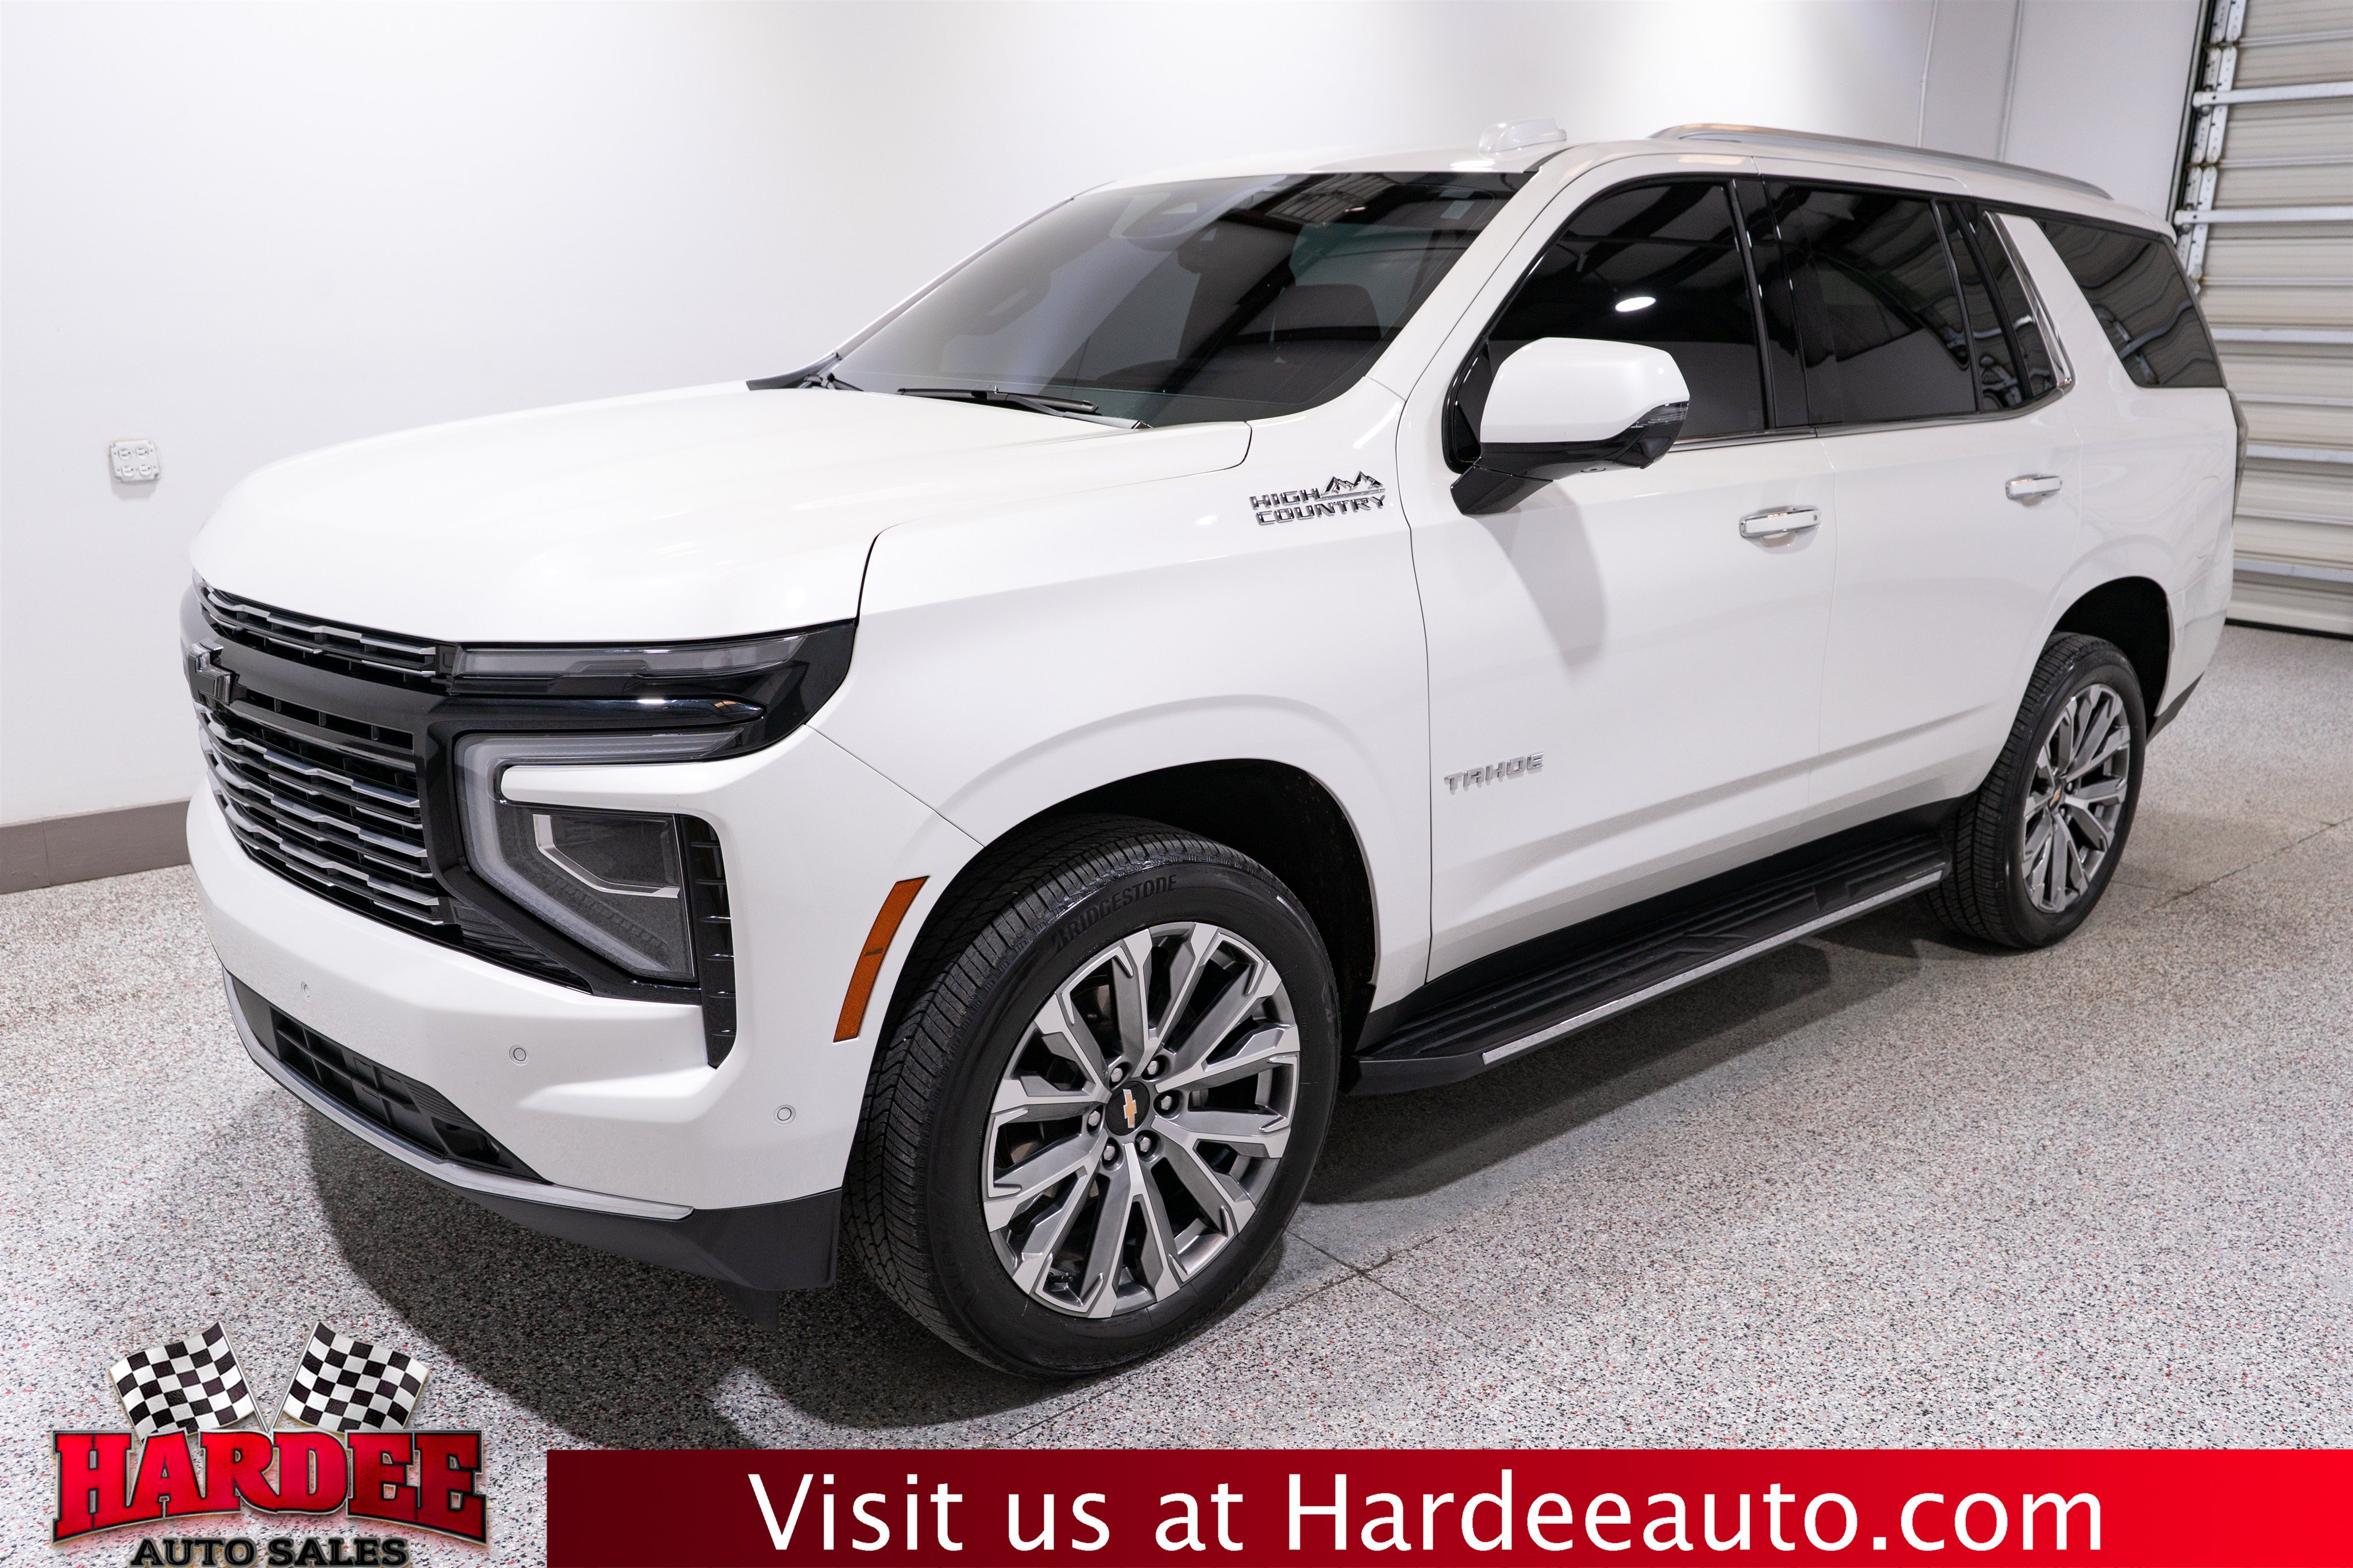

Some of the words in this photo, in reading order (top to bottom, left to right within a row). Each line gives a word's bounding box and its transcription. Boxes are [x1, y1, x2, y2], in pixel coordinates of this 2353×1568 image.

[1249, 488, 1321, 510] HIGH
[1255, 495, 1386, 526] COUNTRY
[1444, 751, 1545, 792] TAHOE
[1051, 874, 1178, 955] BRIDGESTONE
